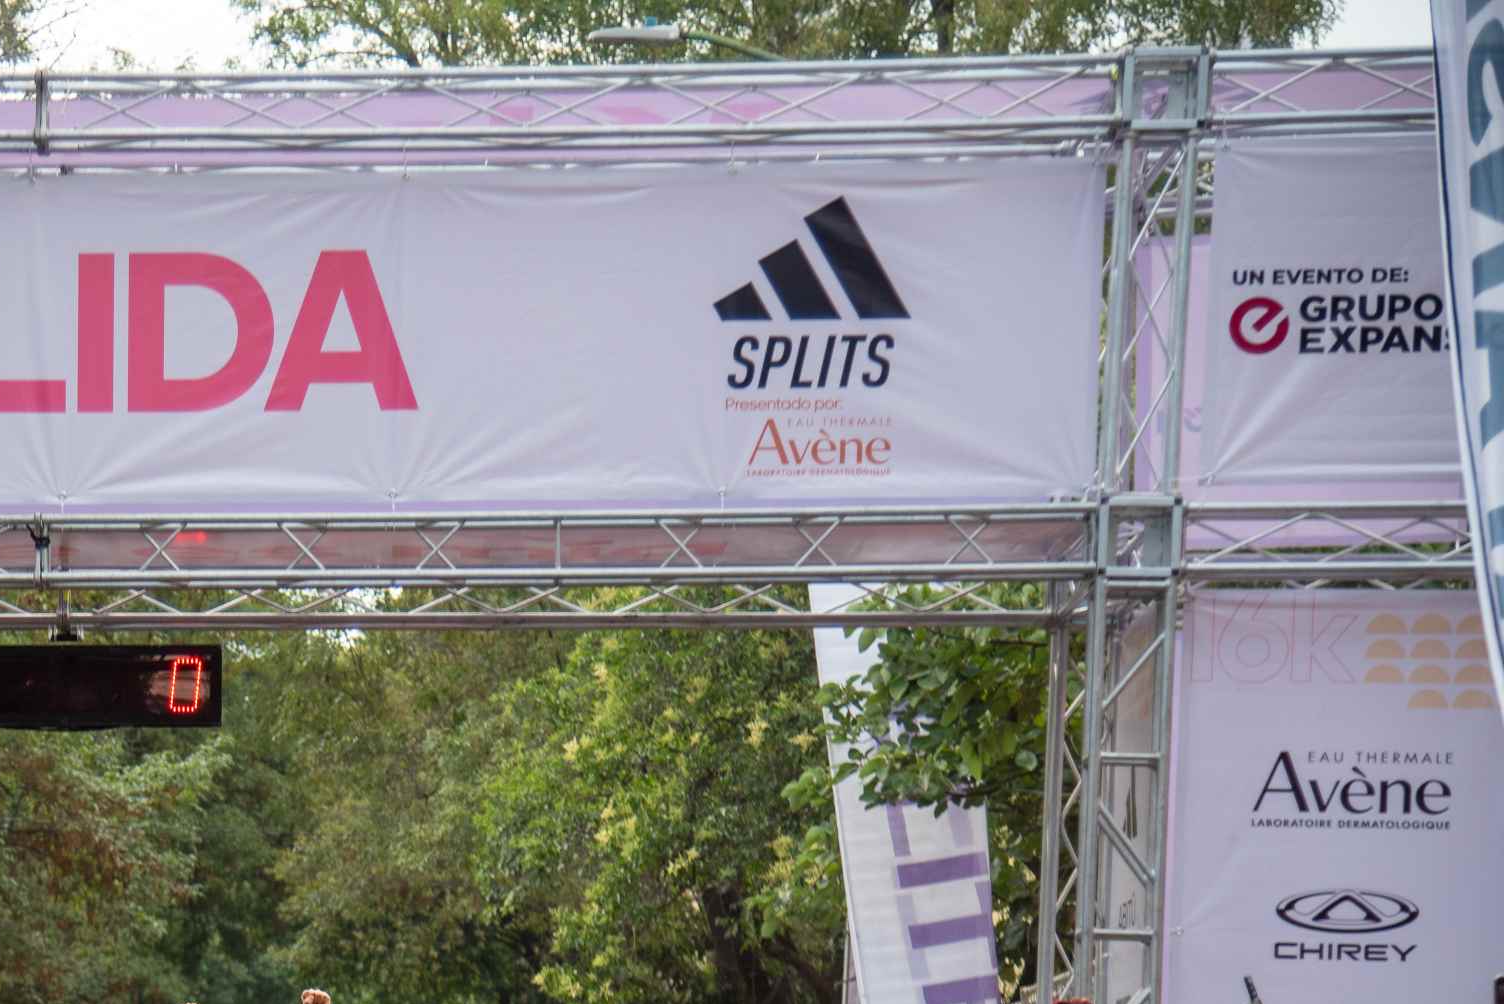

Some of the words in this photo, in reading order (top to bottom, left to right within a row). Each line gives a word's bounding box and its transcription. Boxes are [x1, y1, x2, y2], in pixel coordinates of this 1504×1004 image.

[1233, 270, 1264, 285] UN
[1273, 269, 1363, 285] EVENTO
[1371, 268, 1409, 283] DE:
[1299, 294, 1443, 322] GRUPO
[727, 333, 895, 389] SPLITS
[725, 397, 812, 411] Presentado
[748, 418, 892, 466] Avène
[167, 655, 202, 714] 0
[1308, 751, 1344, 764] EAU
[1357, 751, 1455, 765] THERMALE
[1252, 751, 1452, 815] Avène
[1251, 818, 1332, 829] LABORATOIRE
[1337, 819, 1451, 831] DERMATOLOGIQUE
[1274, 943, 1418, 962] CHIREY
